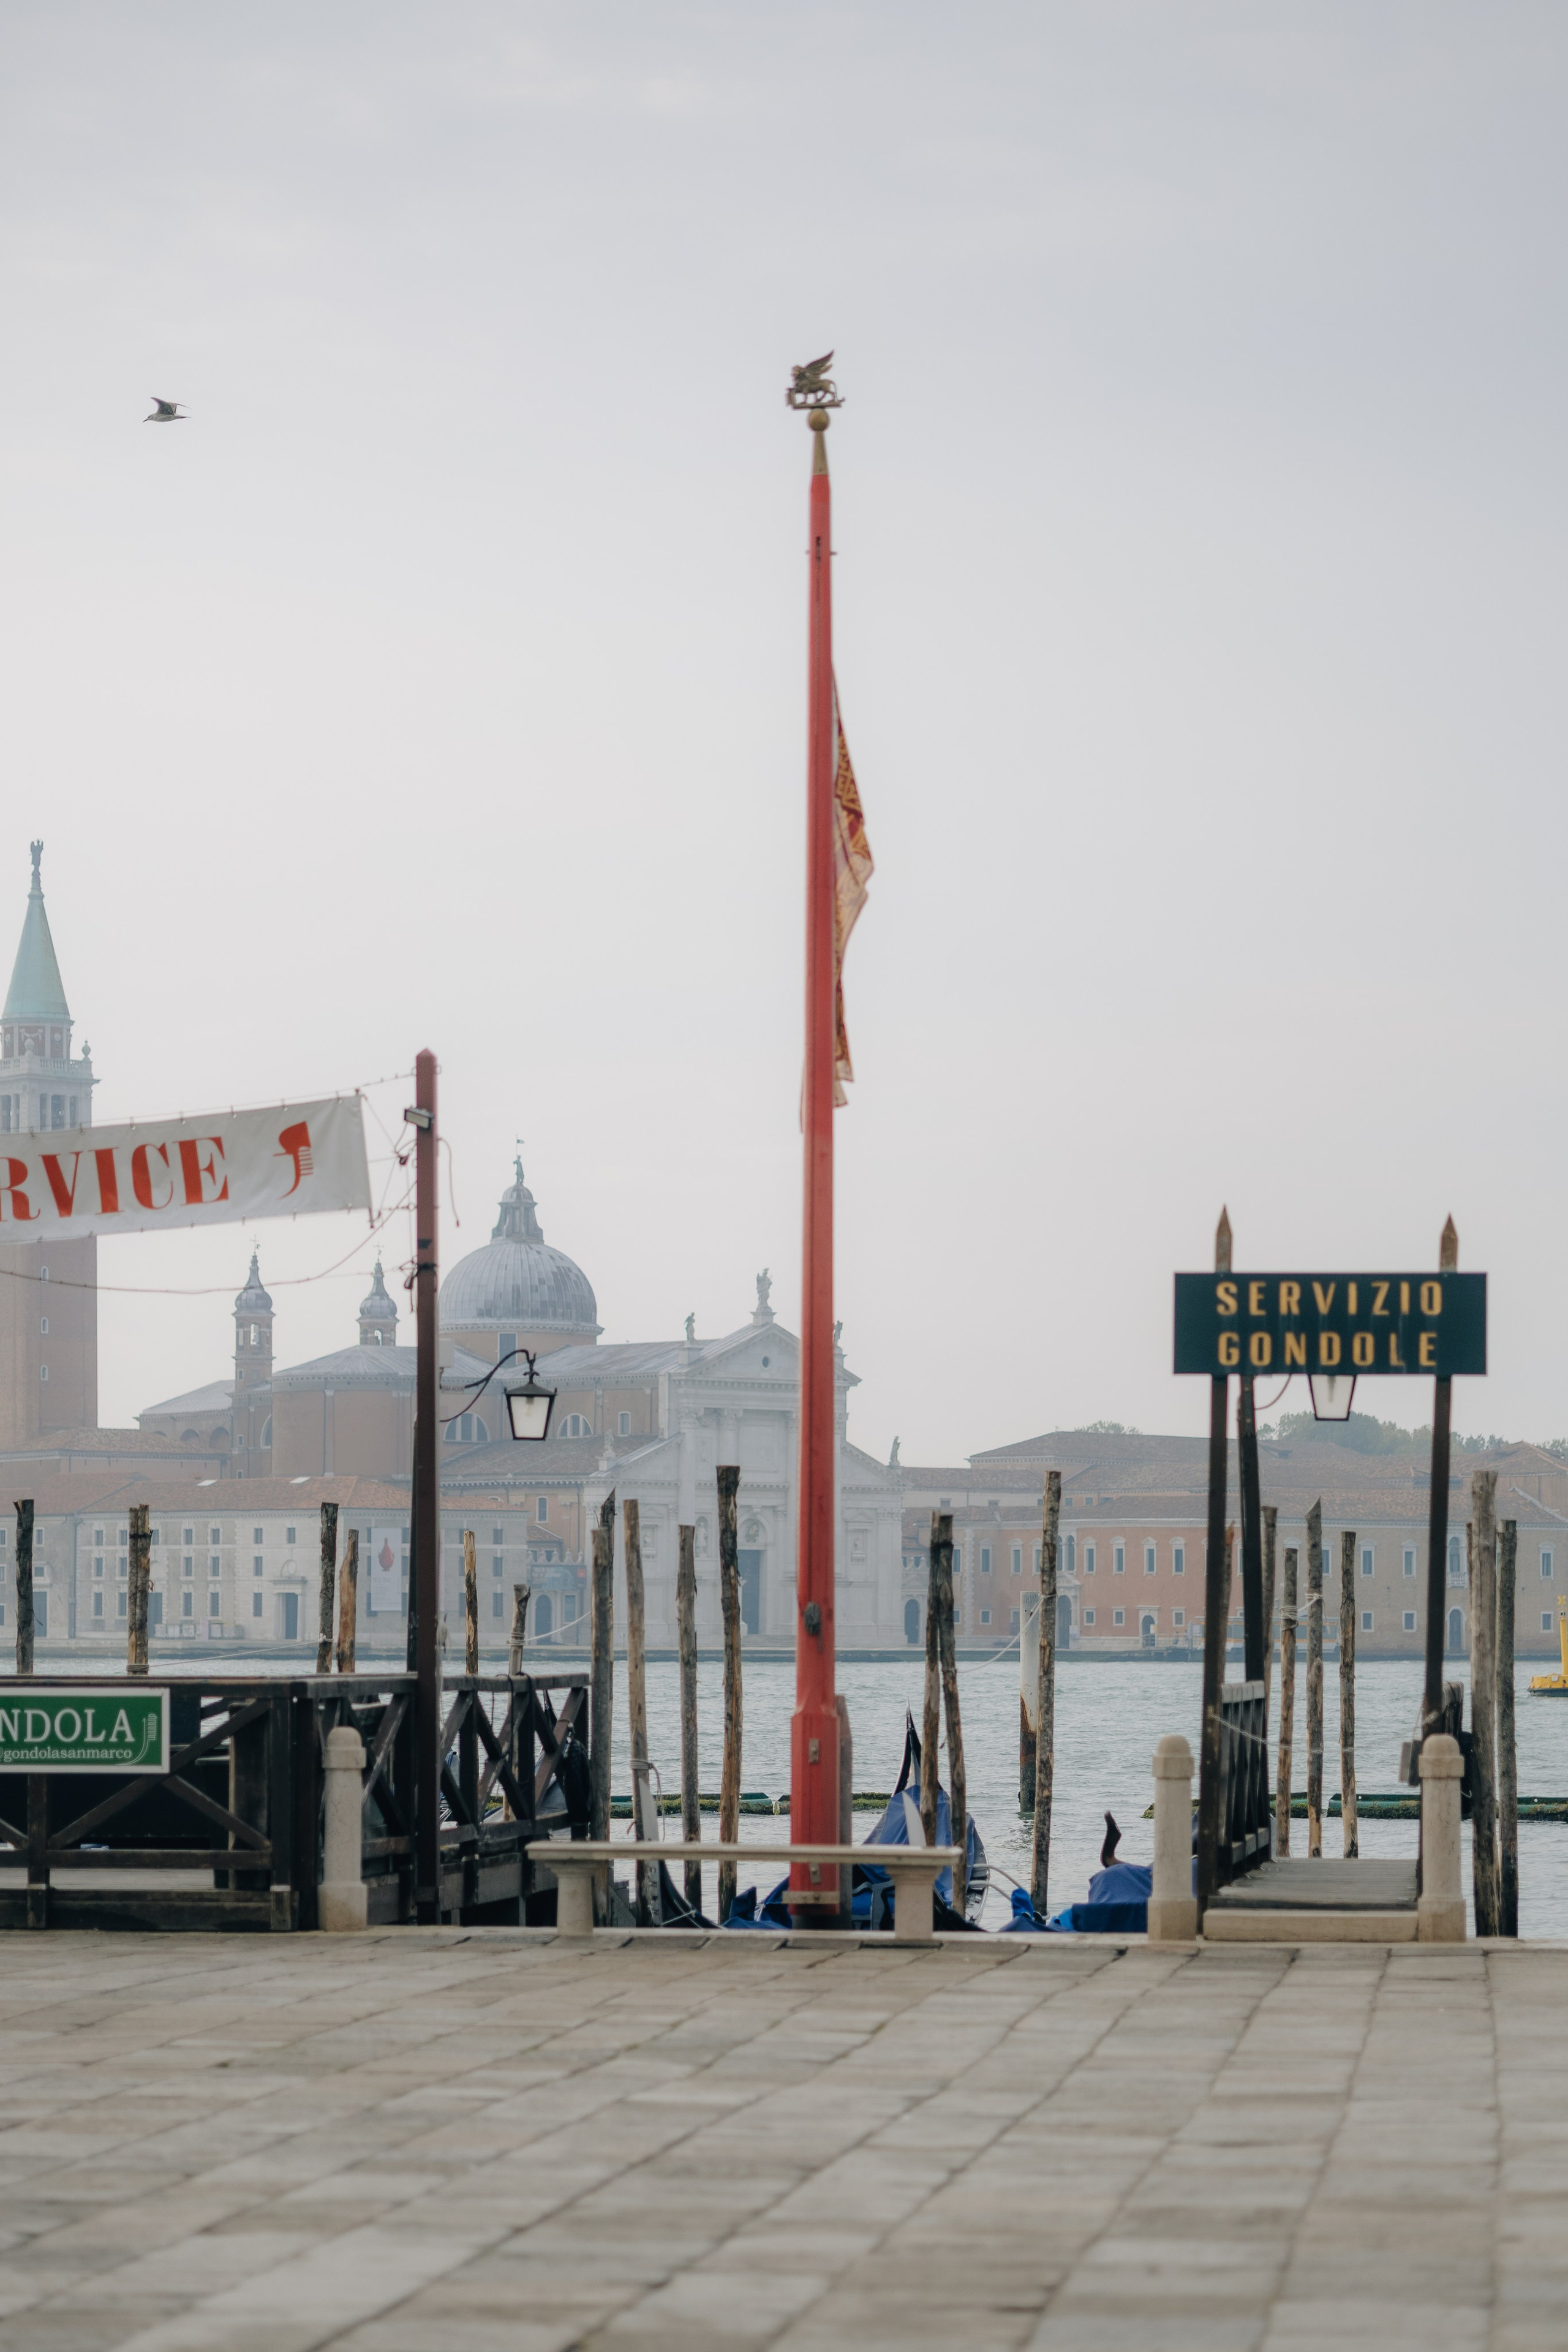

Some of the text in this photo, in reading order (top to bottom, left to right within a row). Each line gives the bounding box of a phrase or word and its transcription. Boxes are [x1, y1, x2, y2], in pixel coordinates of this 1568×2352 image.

[0, 1136, 229, 1221] RVICE
[1216, 1281, 1442, 1316] SERVIZIO
[1218, 1332, 1437, 1366] GONDOLE
[0, 1708, 135, 1743] NDOLA
[0, 1746, 132, 1762] gondolasanmarco
